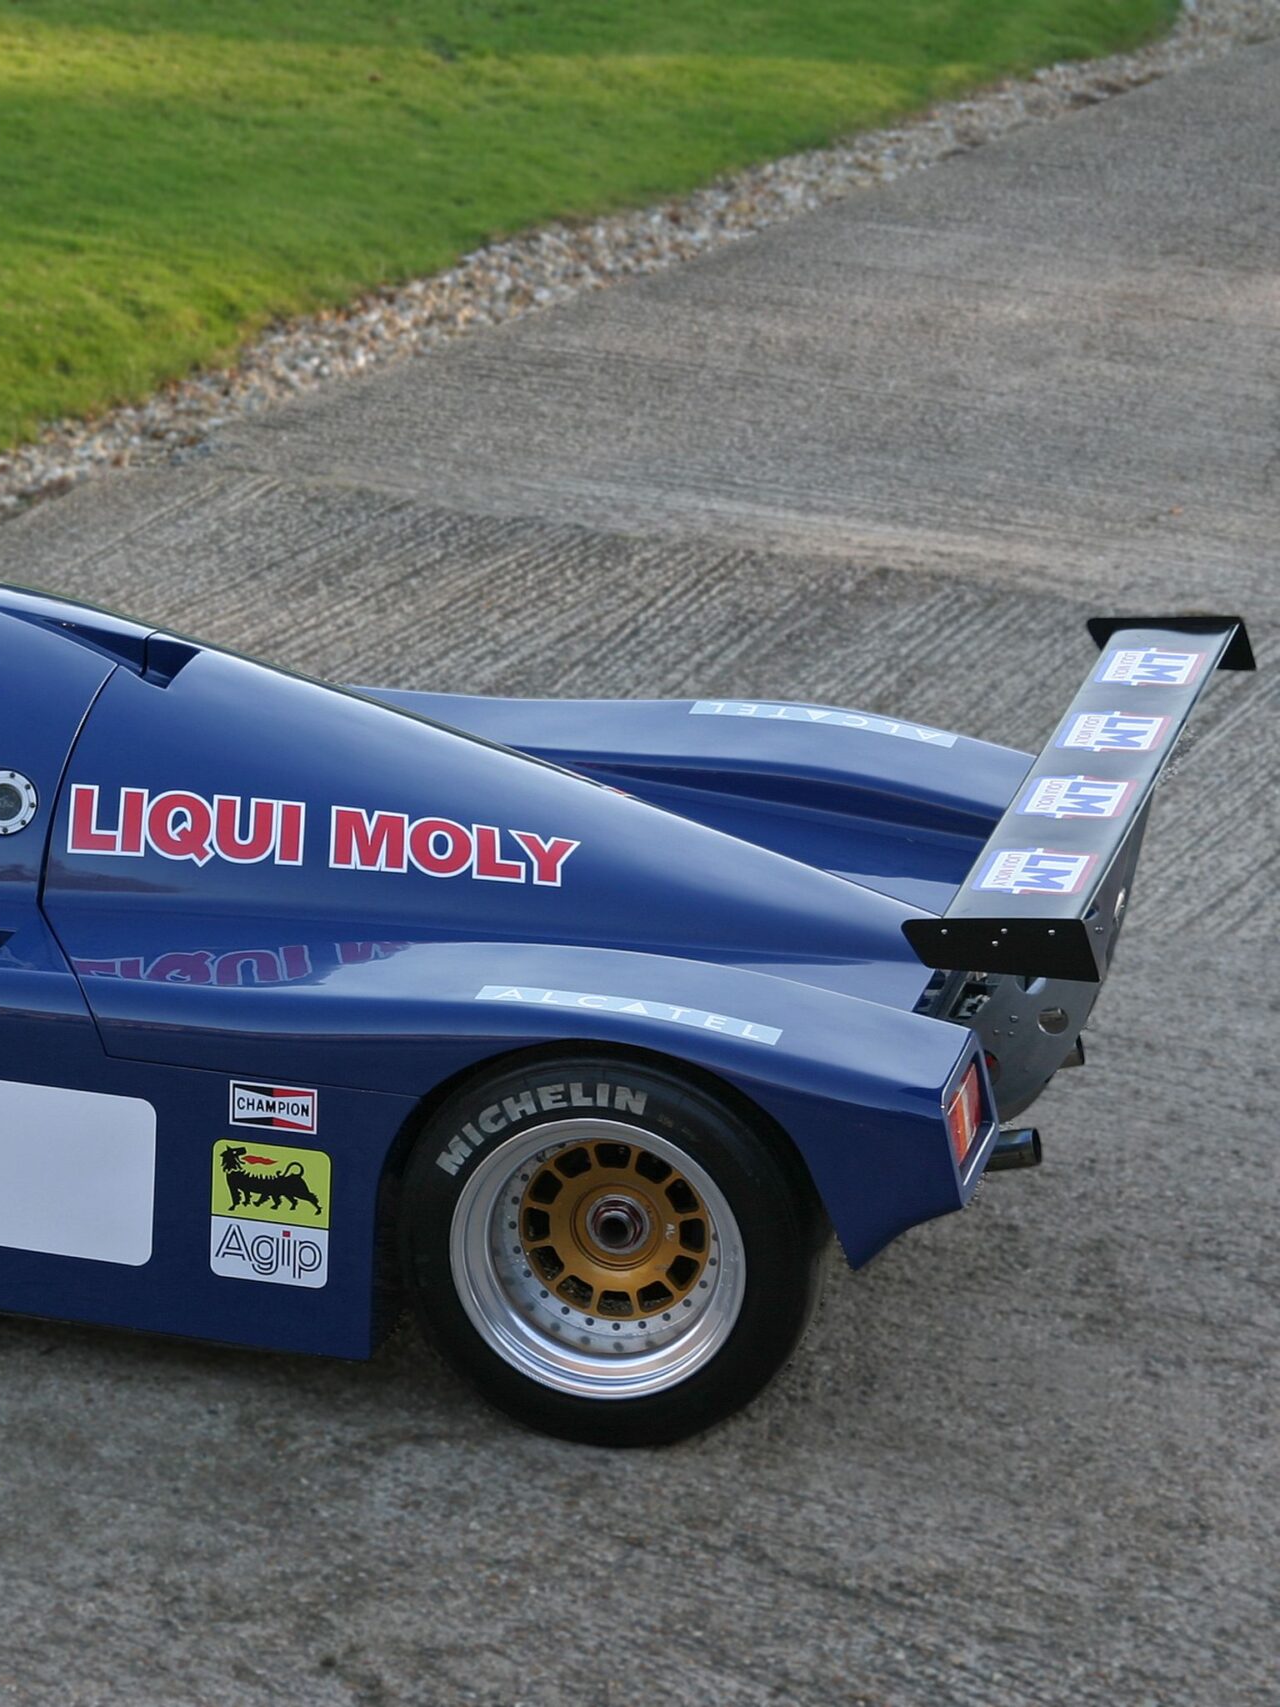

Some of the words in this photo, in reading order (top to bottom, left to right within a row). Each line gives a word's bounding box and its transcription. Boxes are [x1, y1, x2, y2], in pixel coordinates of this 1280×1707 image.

[1131, 653, 1189, 682] LM
[710, 702, 943, 741] ALCATEL
[1093, 717, 1154, 748] LM
[1056, 781, 1119, 814] LM
[67, 783, 305, 868] LIQUI
[328, 805, 580, 887] MOLY
[1013, 855, 1081, 890] LM
[494, 989, 760, 1039] ALCATEL
[236, 1096, 310, 1117] CHAMPION
[435, 1082, 648, 1177] MICHELIN
[215, 1223, 322, 1280] Agip
